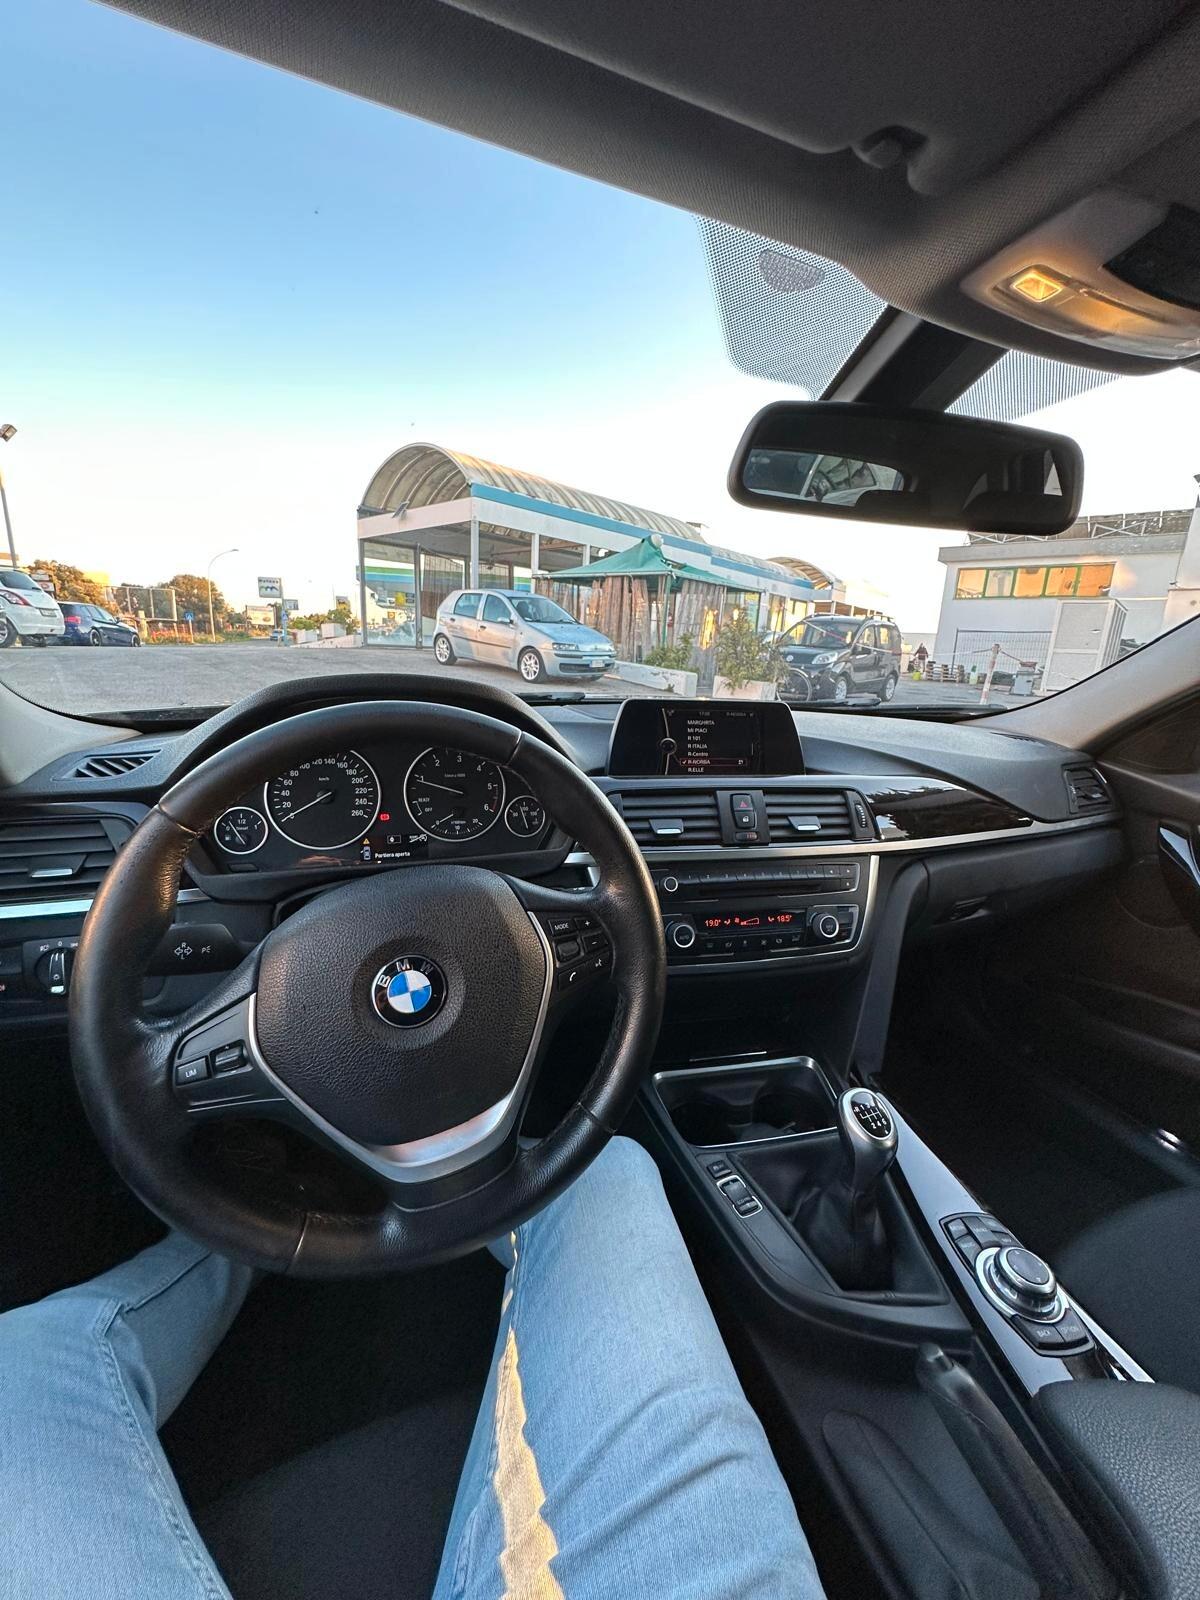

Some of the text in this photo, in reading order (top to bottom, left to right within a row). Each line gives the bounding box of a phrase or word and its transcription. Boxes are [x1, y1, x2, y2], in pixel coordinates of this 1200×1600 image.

[434, 759, 441, 767] 2
[456, 755, 463, 763] 3
[345, 768, 357, 776] 180
[476, 764, 482, 772] 4
[289, 769, 299, 777] 80
[487, 782, 493, 790] 5
[280, 789, 290, 797] 40
[354, 797, 368, 806] 240
[483, 803, 489, 811] 6
[351, 809, 364, 817] 260
[554, 922, 569, 930] MODE
[377, 958, 434, 988] BMW
[185, 1068, 197, 1078] LIM
[881, 1117, 887, 1125] 6
